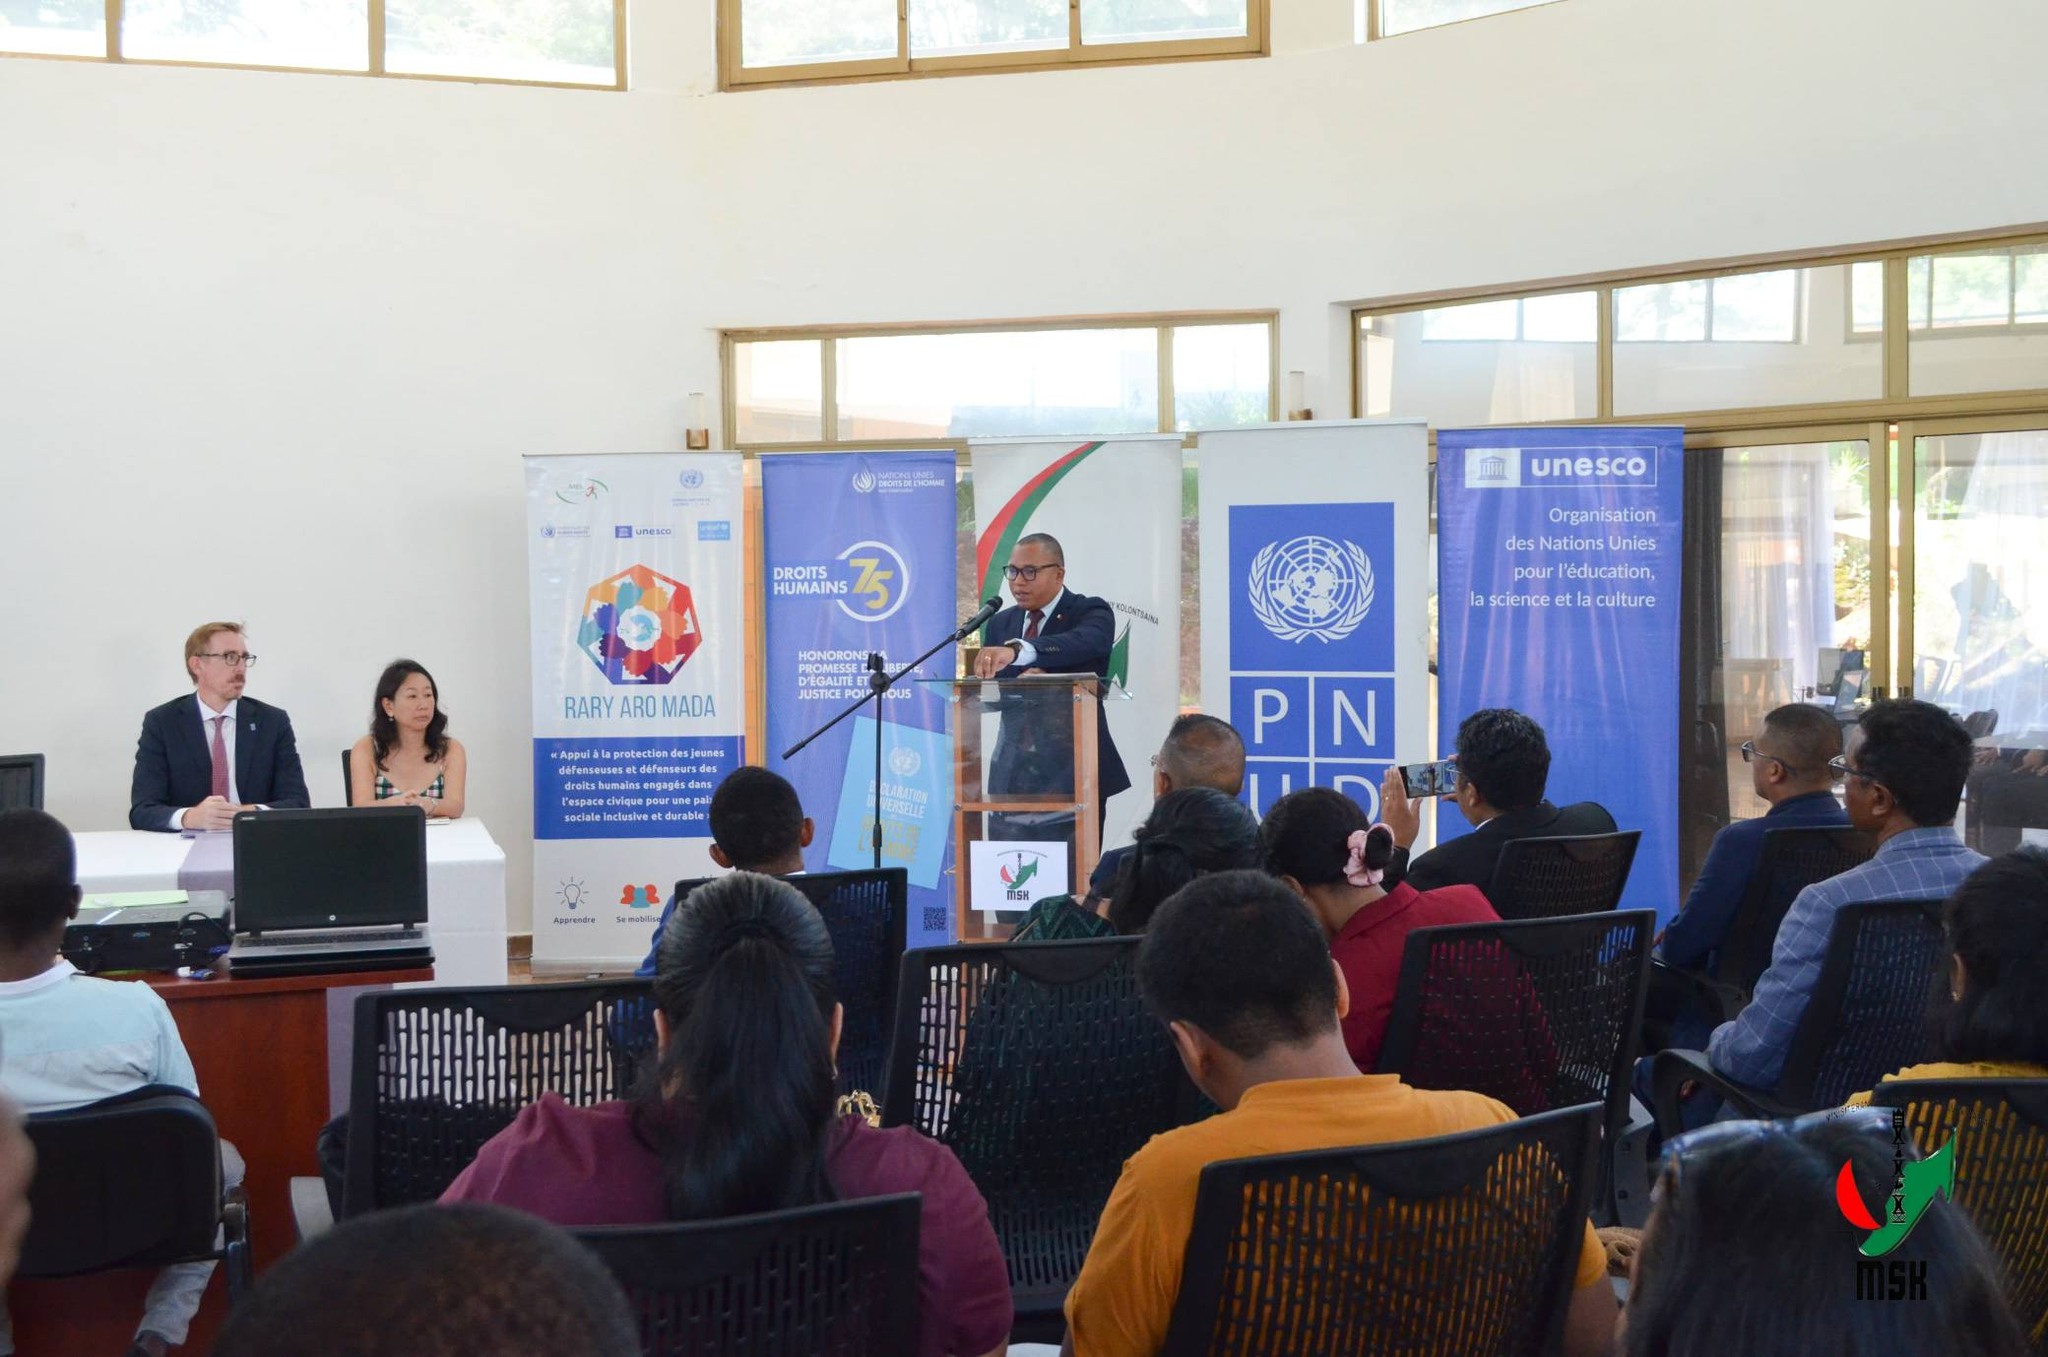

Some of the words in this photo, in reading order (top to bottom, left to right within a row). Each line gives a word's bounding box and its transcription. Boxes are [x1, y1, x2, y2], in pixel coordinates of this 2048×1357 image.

[1531, 456, 1647, 477] unesco
[878, 471, 911, 480] NATIONS
[912, 470, 935, 479] UNIES
[878, 479, 903, 488] DROITS
[903, 479, 913, 487] DE
[913, 479, 945, 487] L'HOMME
[1549, 507, 1656, 526] Organisation
[635, 527, 672, 536] unesco
[1505, 536, 1535, 551] des
[1539, 536, 1604, 551] Nations
[1608, 535, 1656, 550] Unies
[773, 565, 828, 581] DROITS
[1514, 565, 1554, 581] pour
[773, 580, 848, 596] HUMAINS
[849, 558, 894, 610] 75
[1470, 591, 1485, 607] la
[1489, 591, 1550, 607] science
[1554, 593, 1573, 607] et
[1577, 591, 1592, 607] la
[1596, 591, 1656, 608] culture
[1116, 602, 1160, 626] KOLONTSAINA
[798, 650, 868, 661] HONORONS
[798, 663, 858, 674] PROMESSE
[857, 676, 869, 687] ET
[798, 689, 841, 700] JUSTICE
[564, 695, 615, 719] RARY
[619, 694, 657, 719] ARO
[662, 694, 716, 718] MADA
[559, 749, 591, 761] Appui
[592, 749, 599, 759] à
[601, 749, 611, 759] la
[613, 748, 669, 760] protection
[670, 748, 689, 759] des
[689, 748, 725, 759] jeunes
[558, 765, 623, 775] défenseuses
[625, 766, 637, 774] et
[639, 764, 697, 774] défenseurs
[699, 764, 718, 773] des
[564, 781, 596, 790] droits
[598, 780, 641, 790] humains
[643, 779, 686, 792] engagés
[688, 779, 712, 789] dans
[869, 779, 929, 805] DCLARATION
[606, 796, 644, 807] civique
[645, 797, 670, 807] pour
[672, 797, 691, 805] une
[564, 812, 601, 823] sociale
[603, 811, 649, 822] inclusive
[651, 812, 662, 821] et
[664, 810, 705, 820] durable
[1006, 890, 1030, 901] MSK
[553, 915, 596, 925] Apprendre
[616, 915, 626, 923] Se
